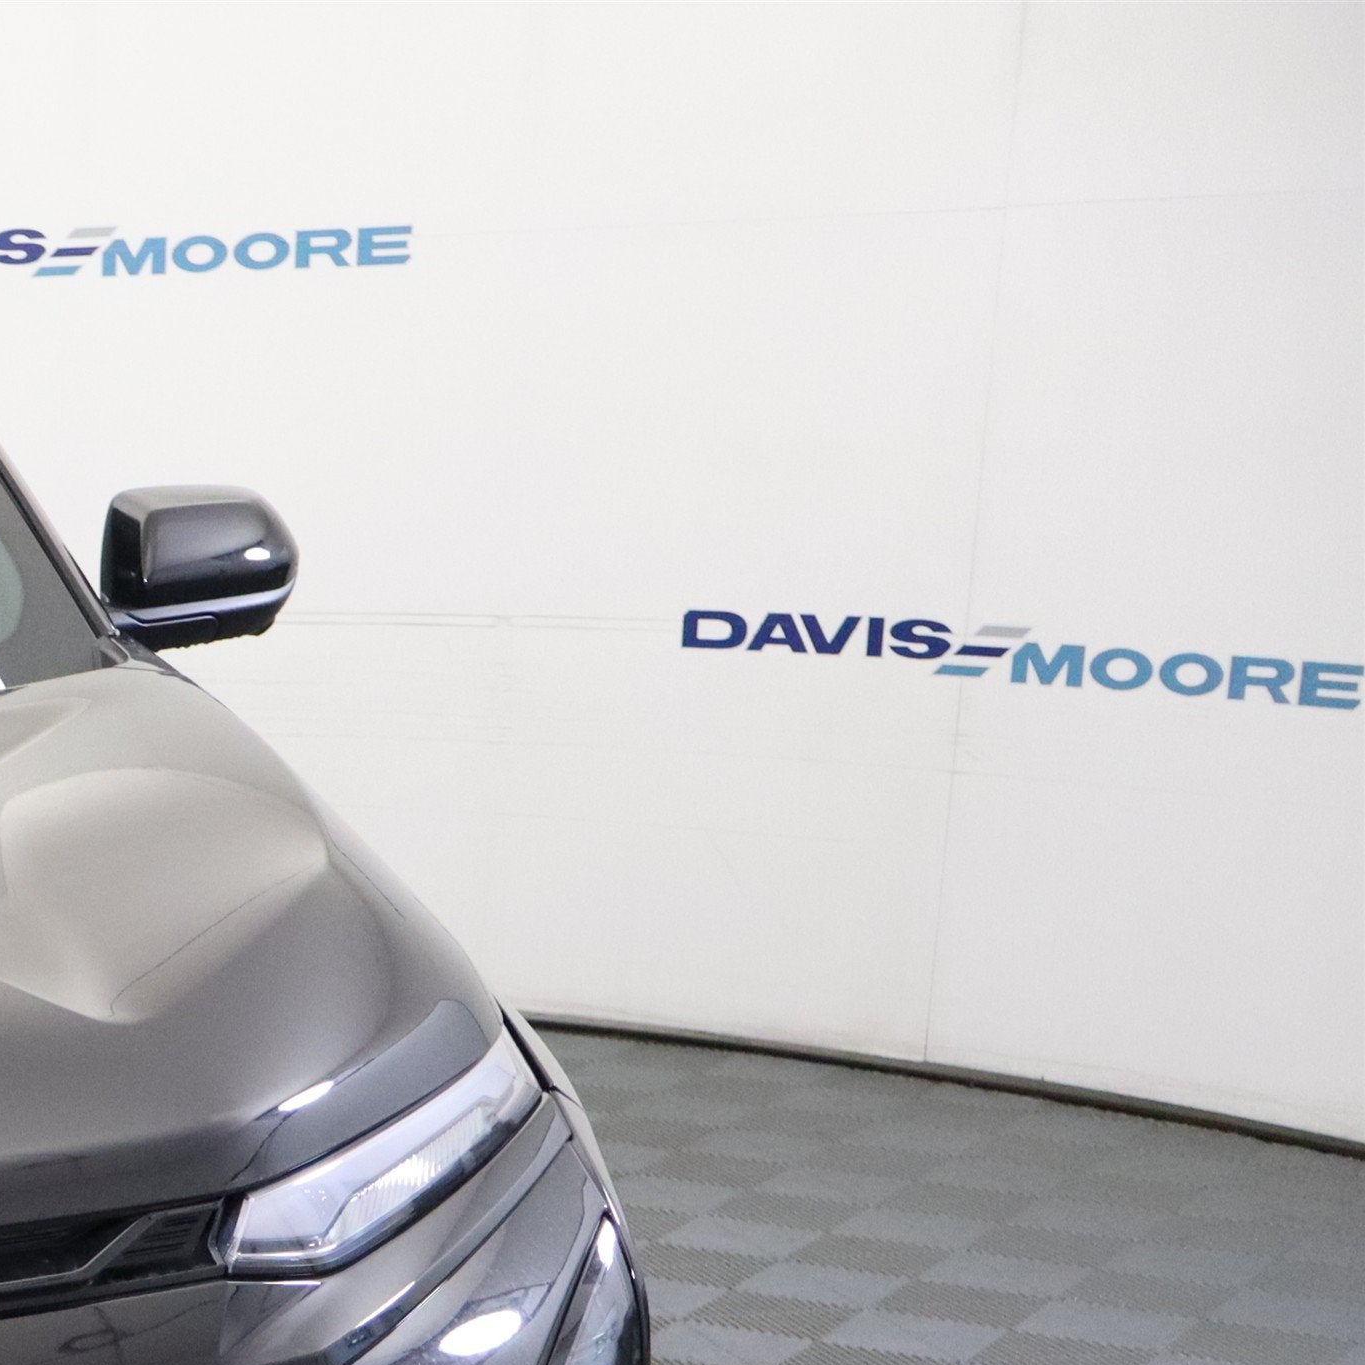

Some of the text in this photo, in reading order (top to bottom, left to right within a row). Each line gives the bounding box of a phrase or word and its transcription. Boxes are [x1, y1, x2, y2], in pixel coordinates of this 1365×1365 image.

[101, 225, 413, 277] MOORE
[682, 609, 1365, 710] DAVIS MOORE
